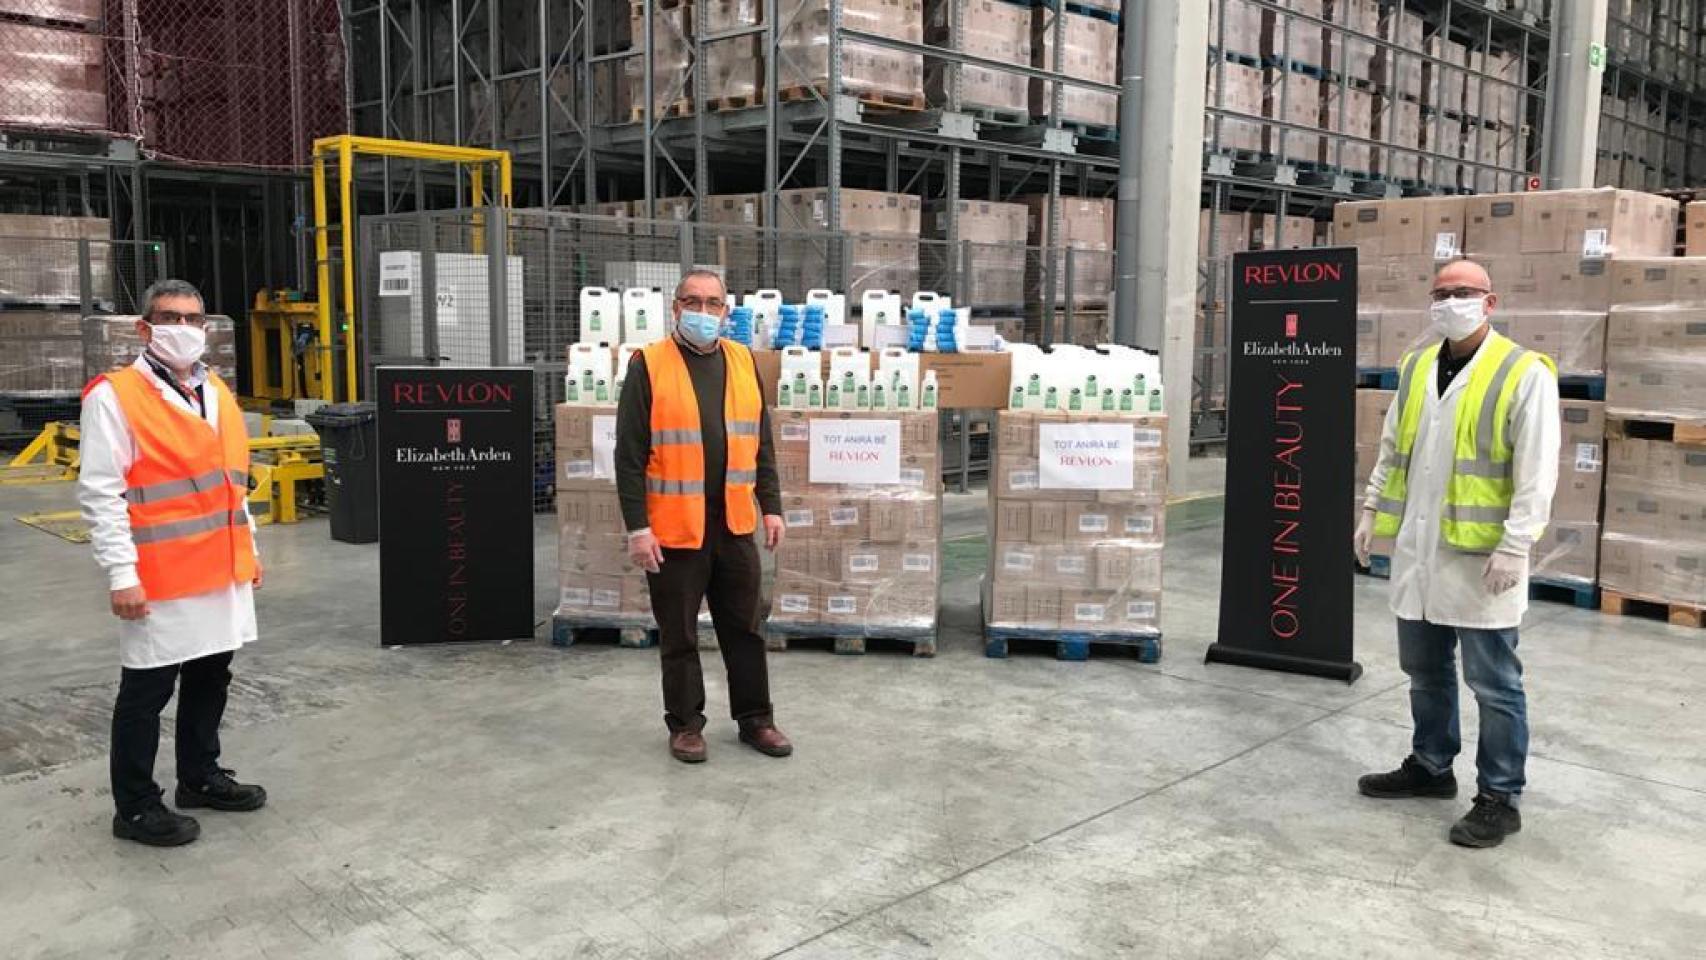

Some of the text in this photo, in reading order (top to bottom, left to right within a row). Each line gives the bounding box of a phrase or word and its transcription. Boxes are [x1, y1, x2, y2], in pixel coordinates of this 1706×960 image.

[1244, 262, 1342, 285] REVLON
[1243, 341, 1342, 356] Elizabeth Arden
[393, 382, 512, 404] REVLON
[396, 446, 511, 462] Elizabeth Arden
[828, 450, 880, 461] REVLON
[1060, 455, 1114, 467] REVLON
[1270, 375, 1304, 638] ONE IN BEAUTY
[447, 479, 466, 560] BEAUTY
[447, 591, 467, 636] ONE
